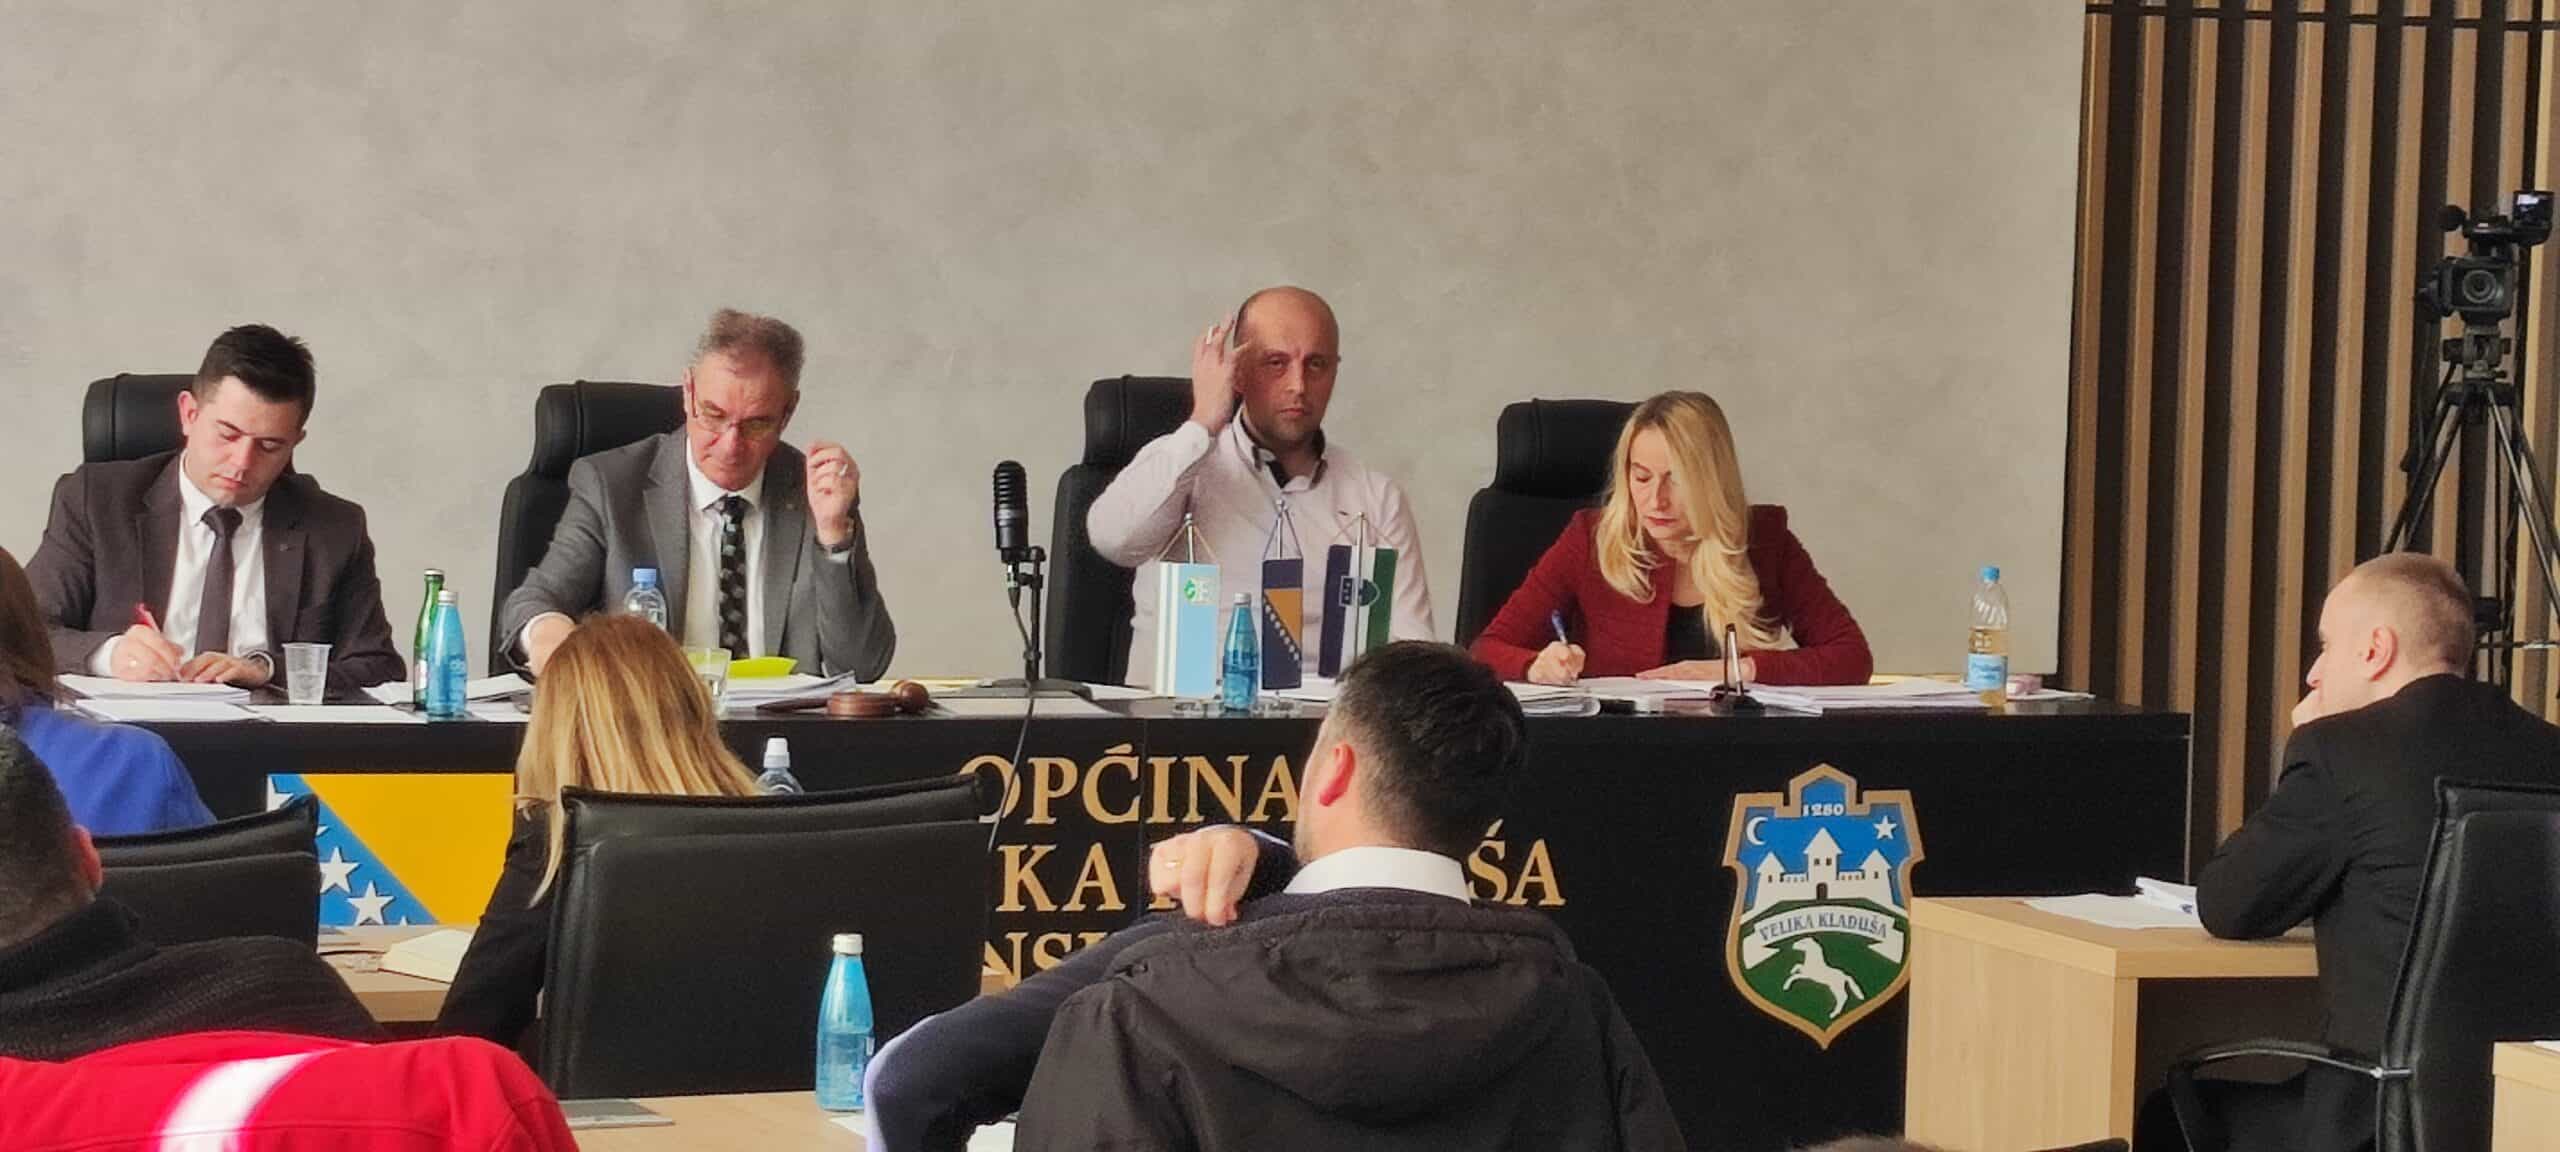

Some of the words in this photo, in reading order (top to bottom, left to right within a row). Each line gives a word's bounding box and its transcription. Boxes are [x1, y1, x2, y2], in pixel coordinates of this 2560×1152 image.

[960, 744, 1299, 824] OPĆINA
[1760, 914, 1813, 940] VELIKA
[1818, 912, 1887, 938] KLADUŠA
